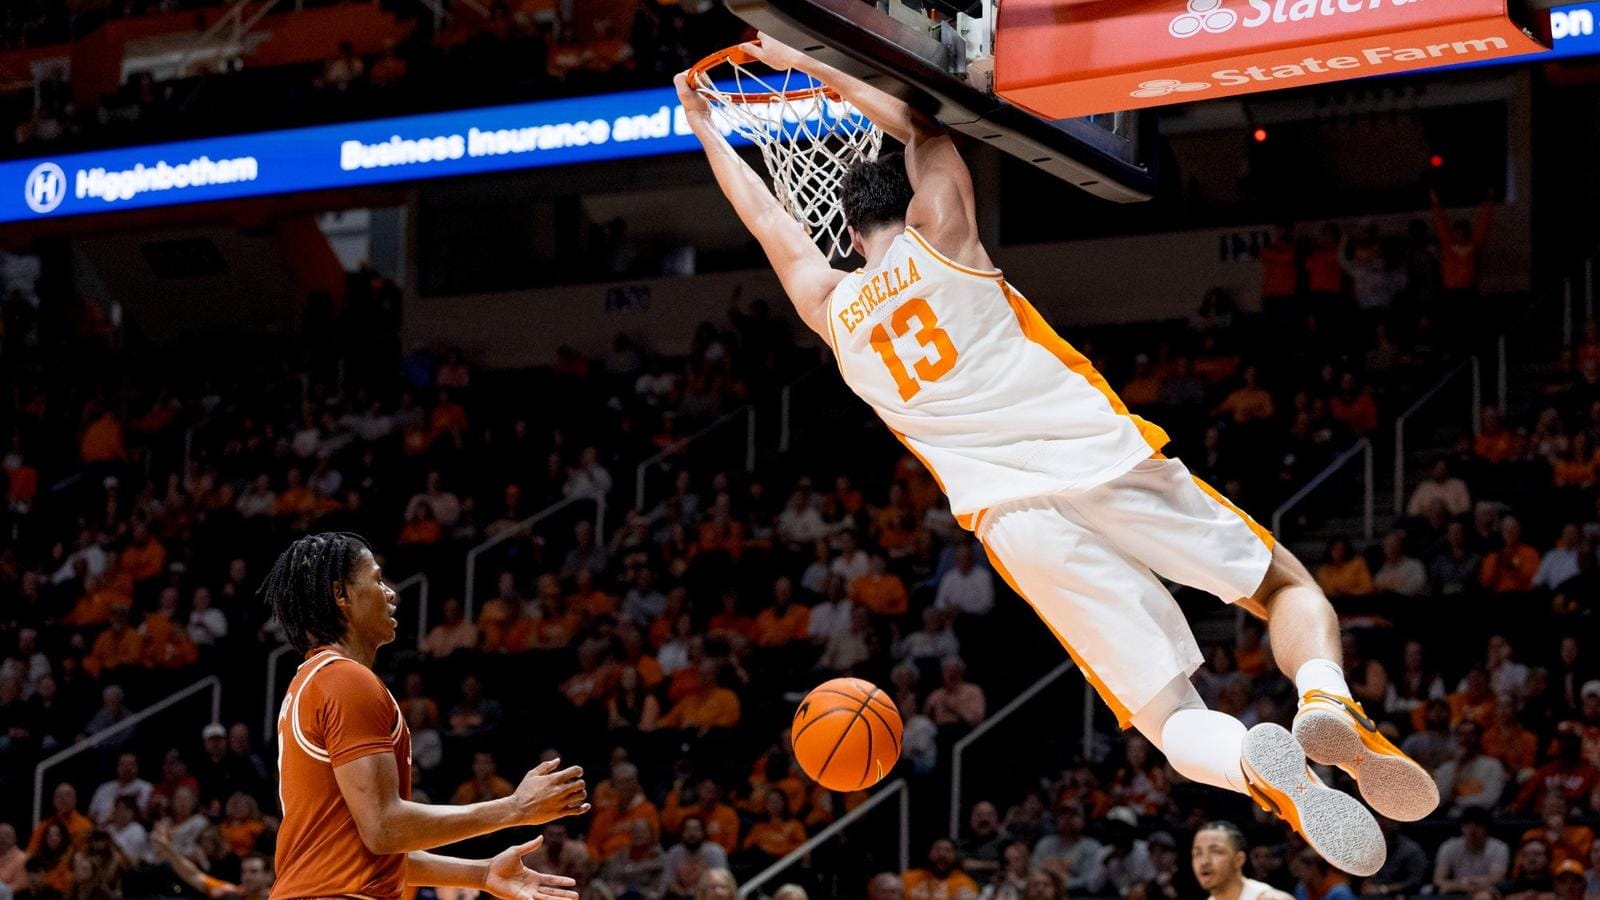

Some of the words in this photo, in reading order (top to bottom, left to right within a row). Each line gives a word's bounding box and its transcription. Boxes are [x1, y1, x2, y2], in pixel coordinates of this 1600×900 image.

[1211, 56, 1361, 86] State
[1361, 35, 1508, 65] Farm
[340, 135, 464, 171] Business
[468, 119, 610, 156] Insurance
[613, 106, 671, 141] and
[75, 155, 258, 202] Higginbotham
[838, 256, 922, 334] ESTRELLA
[869, 297, 959, 403] 13
